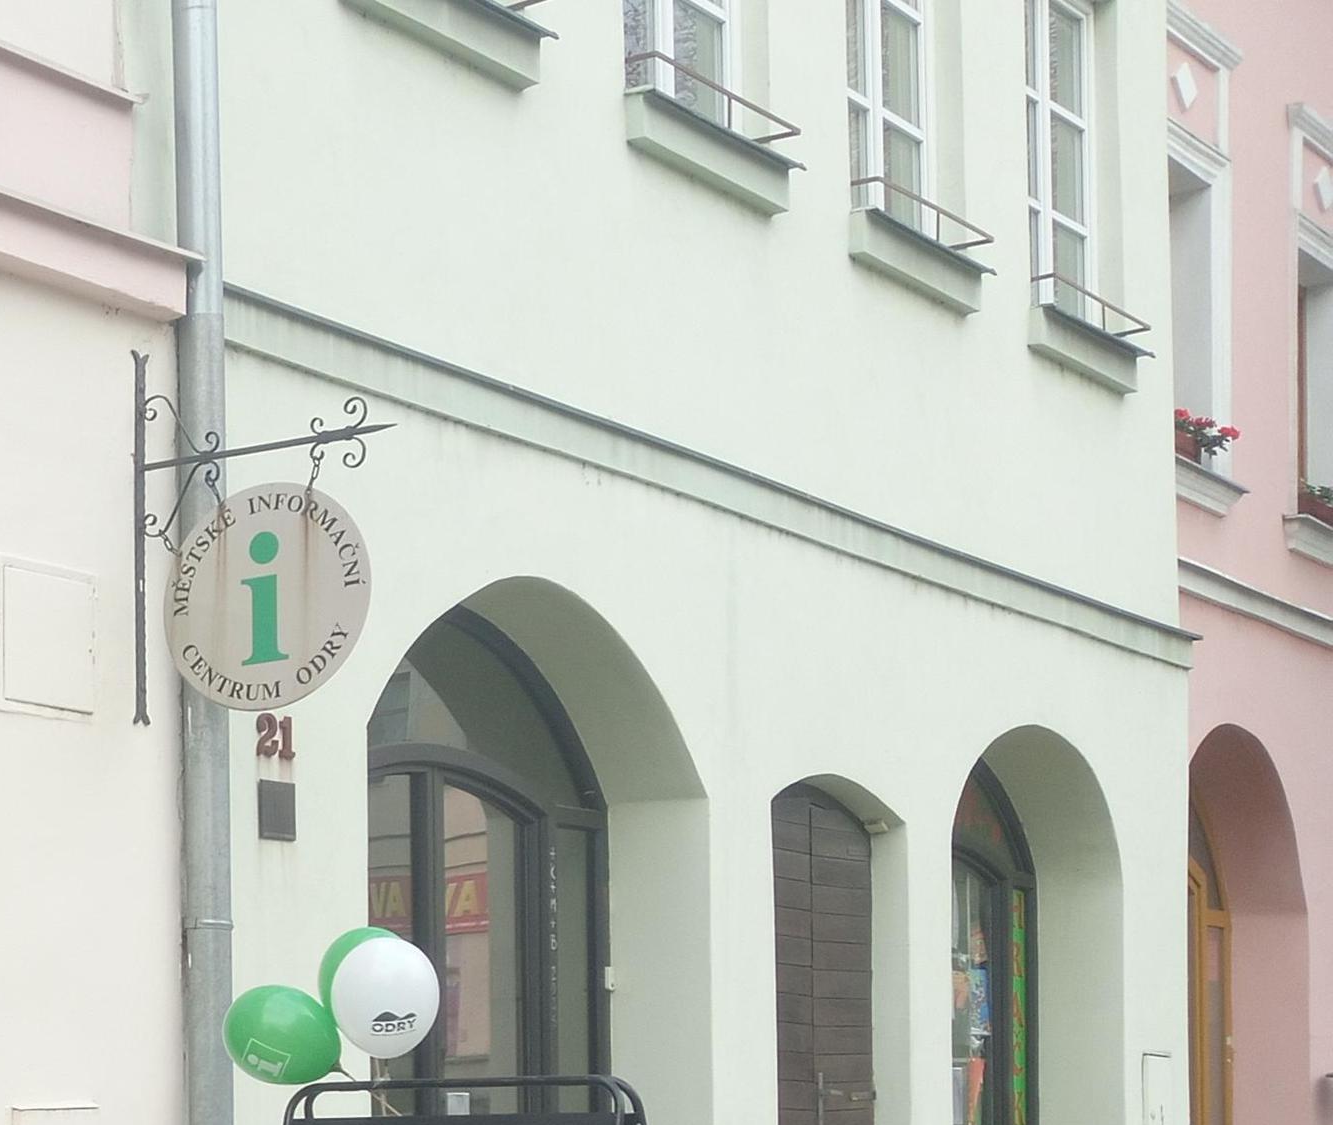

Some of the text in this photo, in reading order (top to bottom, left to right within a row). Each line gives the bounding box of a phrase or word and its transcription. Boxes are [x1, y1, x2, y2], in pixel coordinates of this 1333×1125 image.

[247, 492, 367, 588] INFORMAČNÍ
[181, 622, 351, 701] CENTRUM ODRY
[255, 712, 296, 761] 21
[371, 1019, 417, 1034] ODRY
